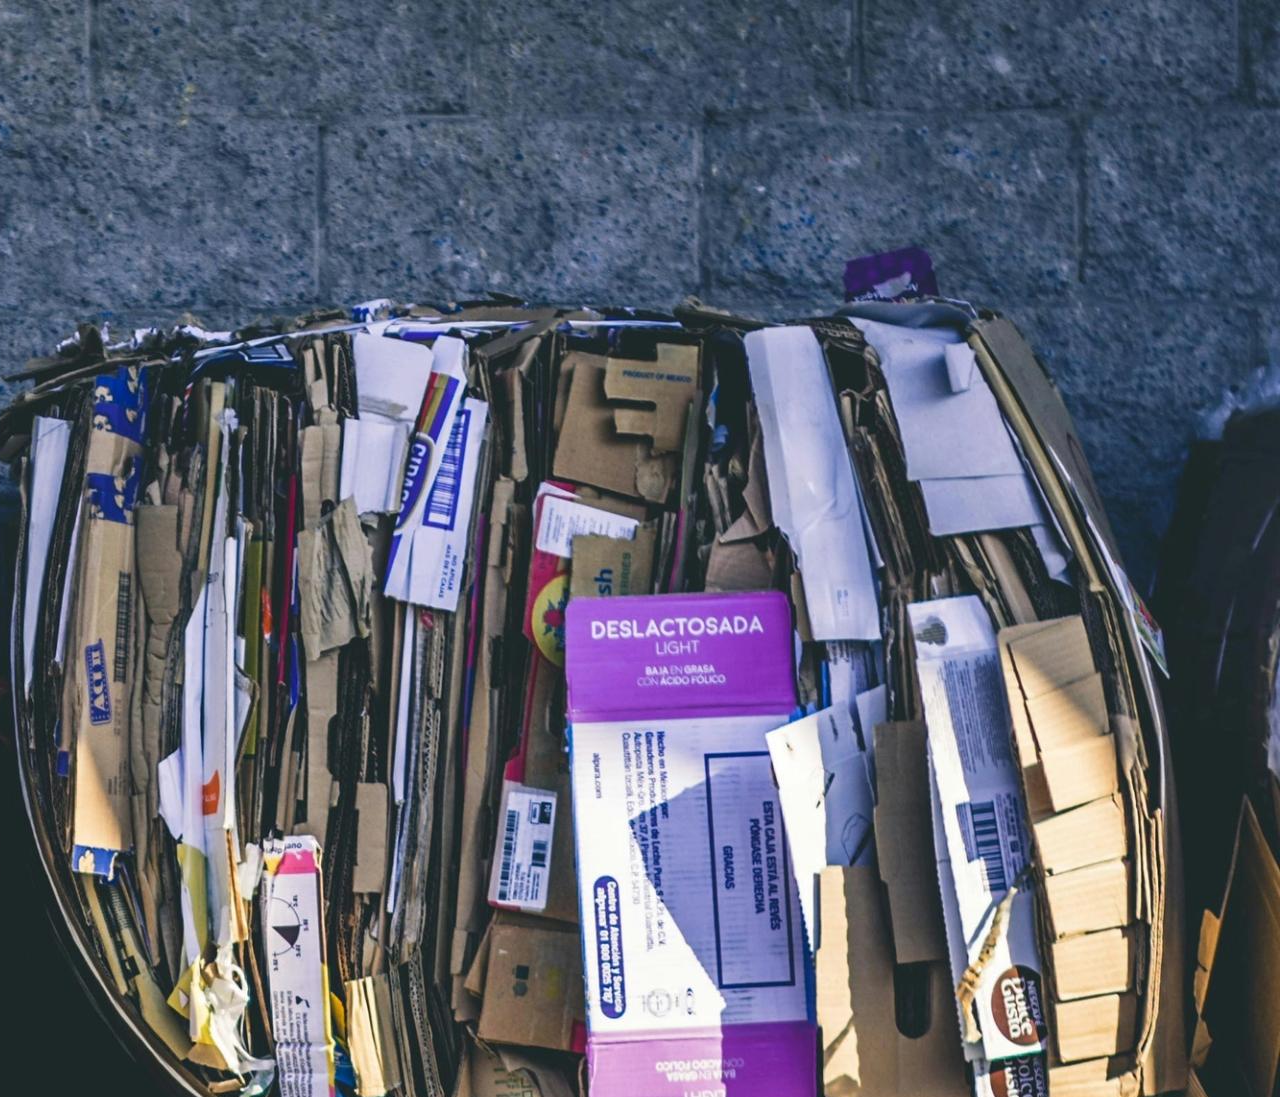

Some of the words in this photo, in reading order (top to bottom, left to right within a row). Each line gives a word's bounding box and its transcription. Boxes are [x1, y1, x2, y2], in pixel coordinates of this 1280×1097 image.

[591, 615, 764, 639] DESLACTOSADA
[655, 640, 700, 656] LIGHT
[637, 677, 659, 687] CON
[660, 674, 690, 686] ÁCIDO
[691, 673, 726, 685] FÓLICO
[645, 665, 669, 675] BAJA
[670, 664, 683, 674] EN
[684, 664, 715, 674] GRASA
[656, 731, 666, 757] Hecho
[590, 752, 604, 799] alpura.com
[761, 800, 775, 828] ESTA
[747, 817, 764, 865] PÓNGASE
[763, 827, 777, 855] CAJA
[721, 845, 736, 889] GRACIAS
[765, 855, 780, 880] ESTÁ
[604, 880, 618, 911] Centro
[751, 866, 767, 913] DERECHA
[767, 880, 780, 896] AL
[607, 911, 618, 924] de
[768, 897, 784, 931] REVÉS
[607, 926, 623, 966] Atención
[612, 975, 625, 1012] Servicio
[1000, 978, 1021, 1038] Gusto
